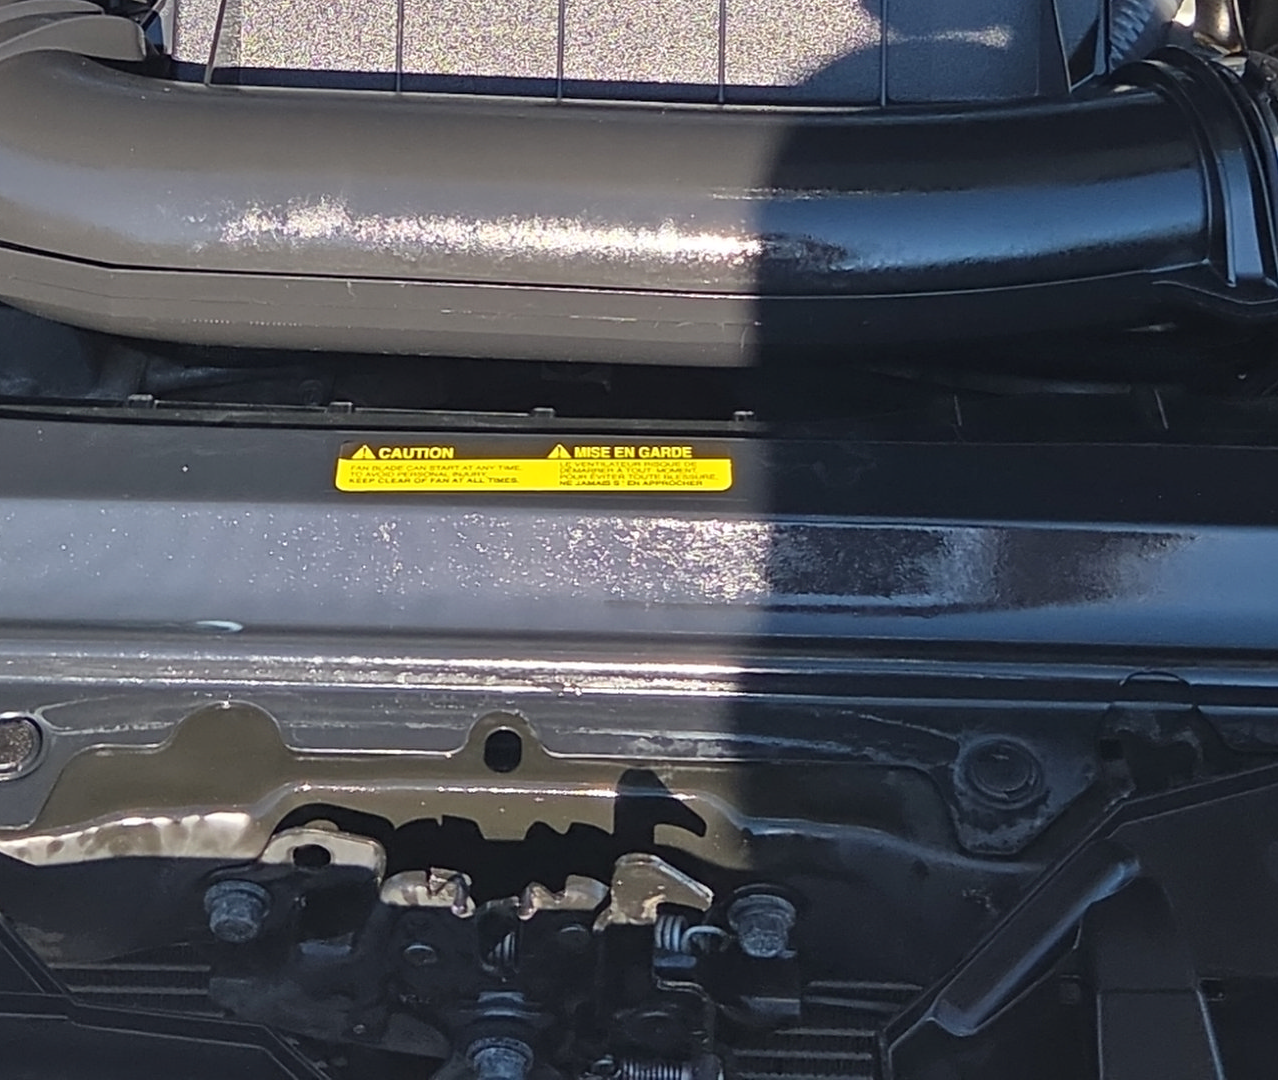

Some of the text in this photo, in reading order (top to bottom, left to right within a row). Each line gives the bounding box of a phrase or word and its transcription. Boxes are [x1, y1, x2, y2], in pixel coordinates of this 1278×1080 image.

[378, 447, 455, 459] CAUTION
[574, 446, 693, 458] MISE EN GARDE
